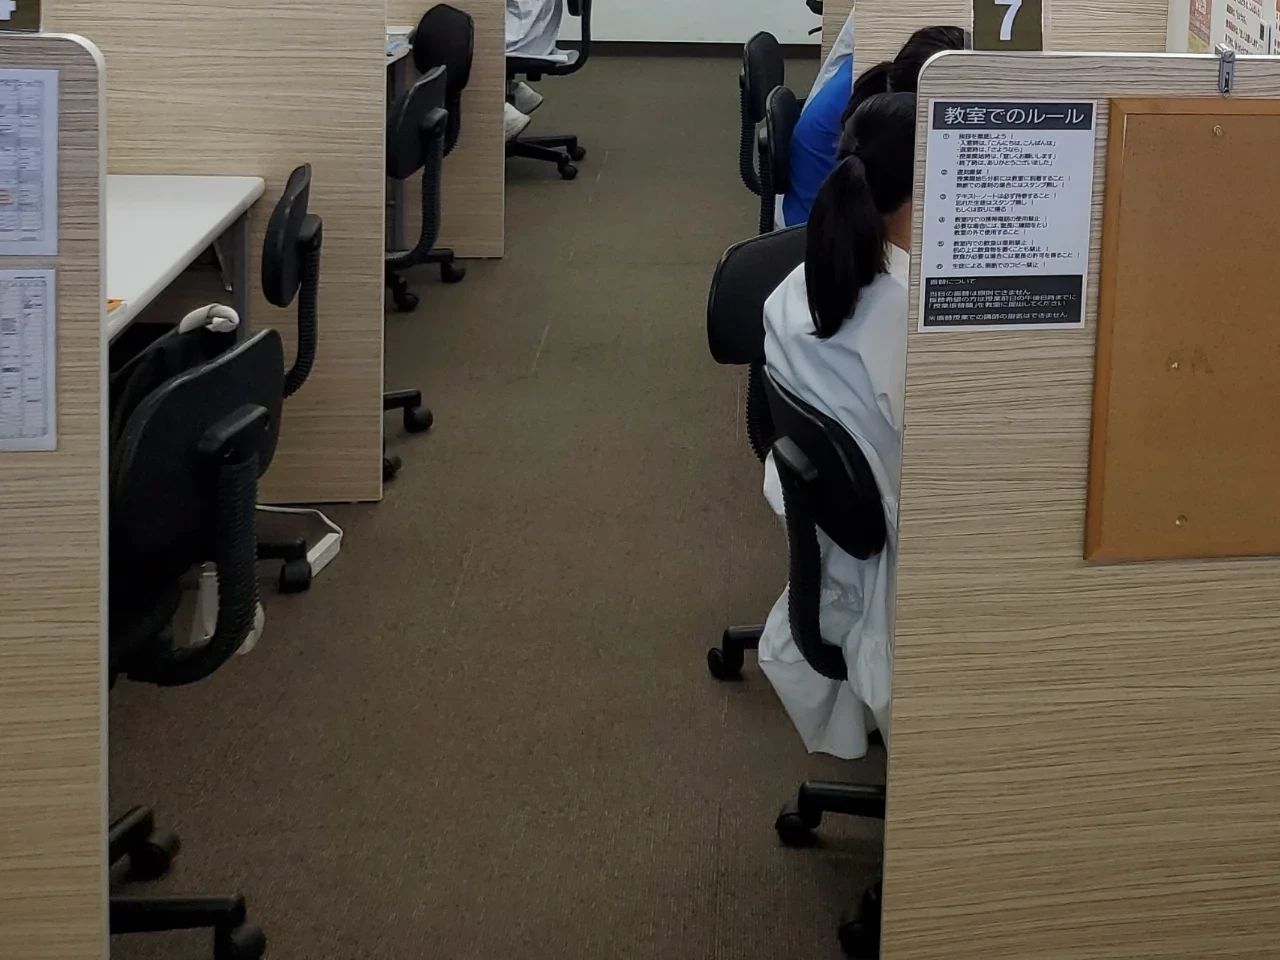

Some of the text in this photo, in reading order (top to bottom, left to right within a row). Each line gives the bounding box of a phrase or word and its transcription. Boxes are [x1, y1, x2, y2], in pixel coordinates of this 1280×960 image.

[943, 106, 1085, 125] 教室でのルール
